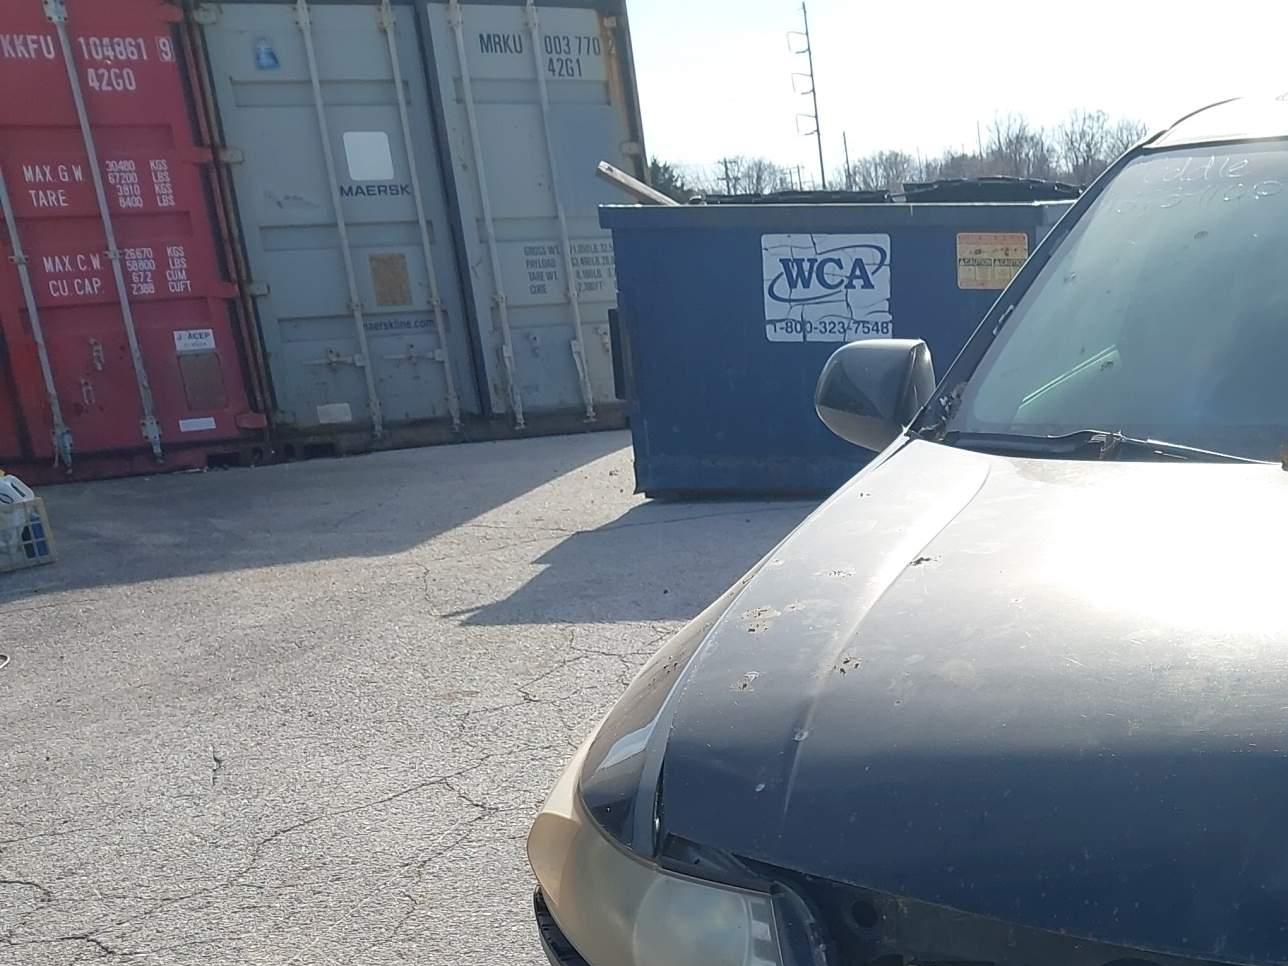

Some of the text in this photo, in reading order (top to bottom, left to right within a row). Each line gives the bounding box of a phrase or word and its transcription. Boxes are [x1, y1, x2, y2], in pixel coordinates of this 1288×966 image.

[0, 33, 172, 61] KKFU 104861 9
[479, 33, 524, 54] MRKU
[544, 35, 571, 55] 003
[575, 36, 601, 56] 770
[548, 57, 583, 77] 42G1
[149, 159, 168, 171] KGS
[108, 171, 171, 185] 67200 LBS
[154, 183, 173, 195] KGS
[339, 183, 411, 197] MAERSK
[29, 189, 69, 208] TARE
[156, 194, 176, 208] LBS
[166, 245, 185, 257] KGS
[168, 257, 187, 269] LBS
[166, 268, 187, 281] CUM
[778, 257, 875, 290] WCA
[168, 280, 192, 293] CUFT
[772, 321, 890, 334] 1-800-323-7548
